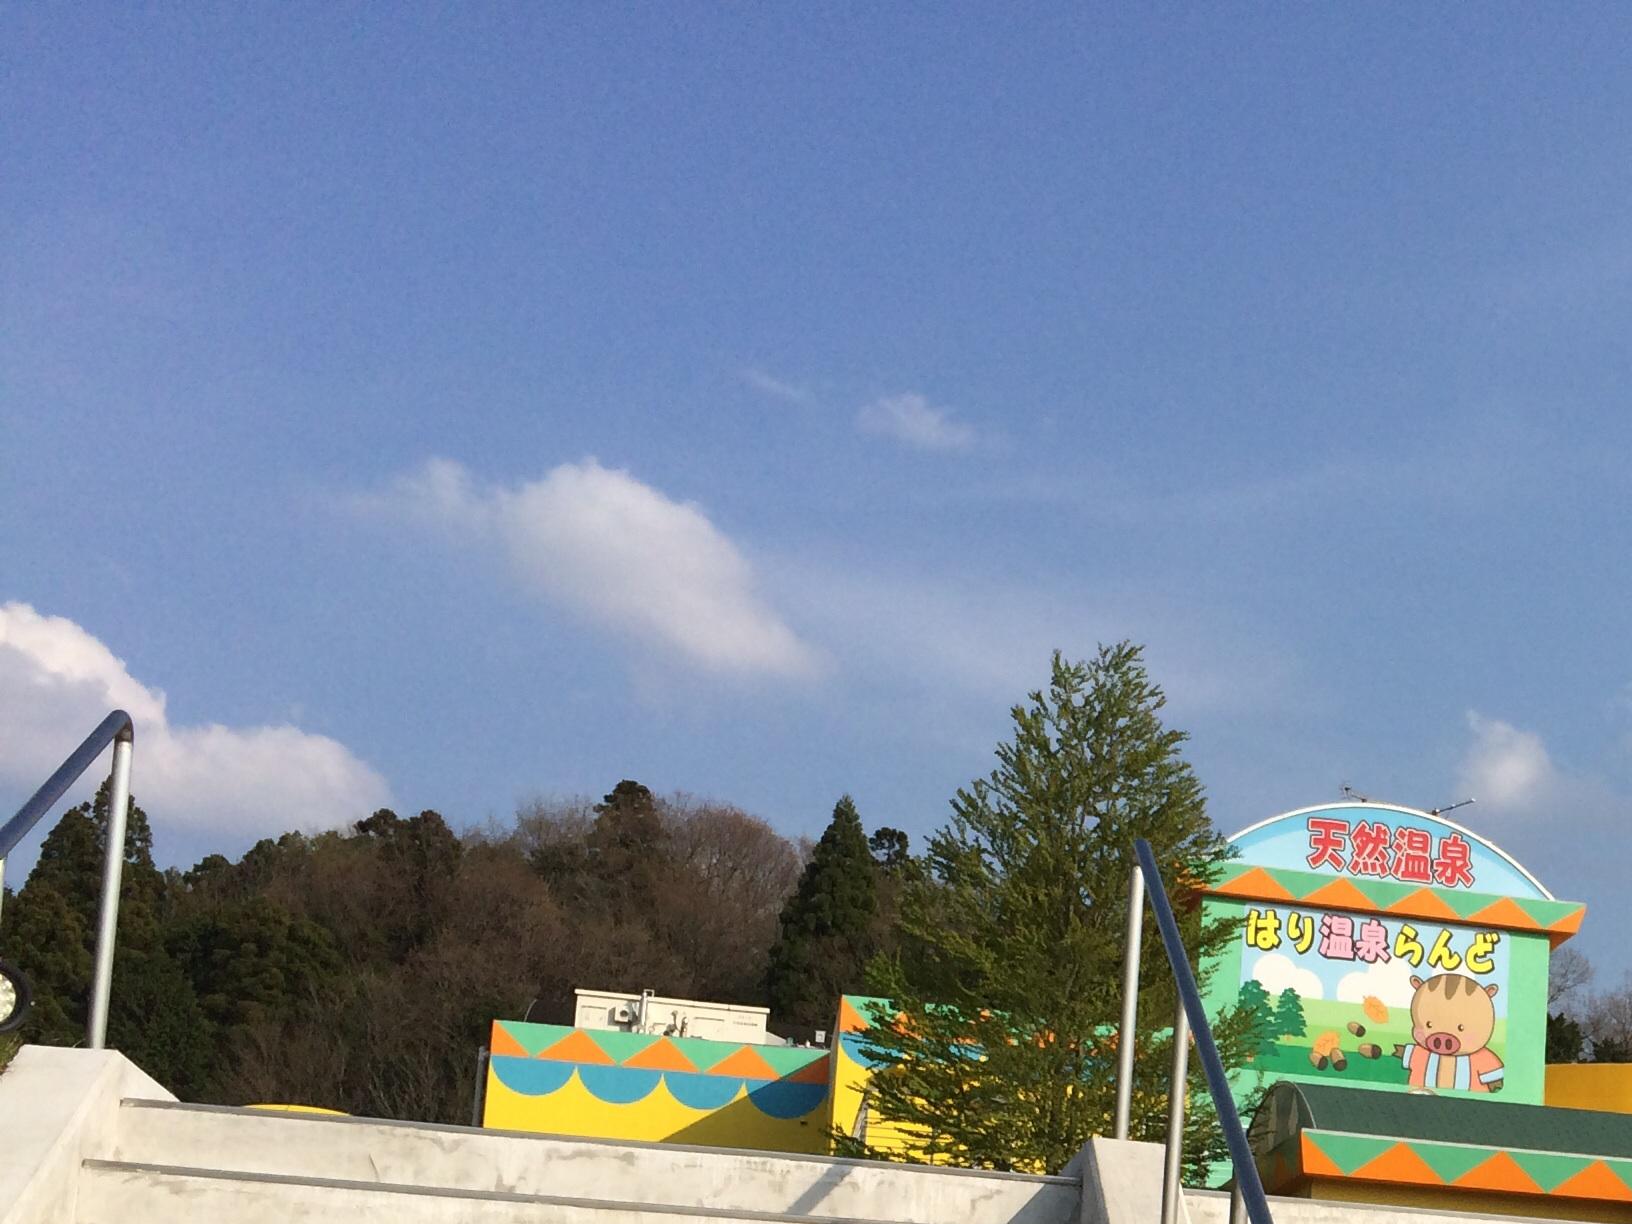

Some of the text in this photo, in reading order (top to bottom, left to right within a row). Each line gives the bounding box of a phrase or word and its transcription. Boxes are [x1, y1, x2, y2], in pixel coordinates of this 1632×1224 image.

[1307, 817, 1475, 887] 天然温泉
[1246, 909, 1499, 974] はり温泉らんど
